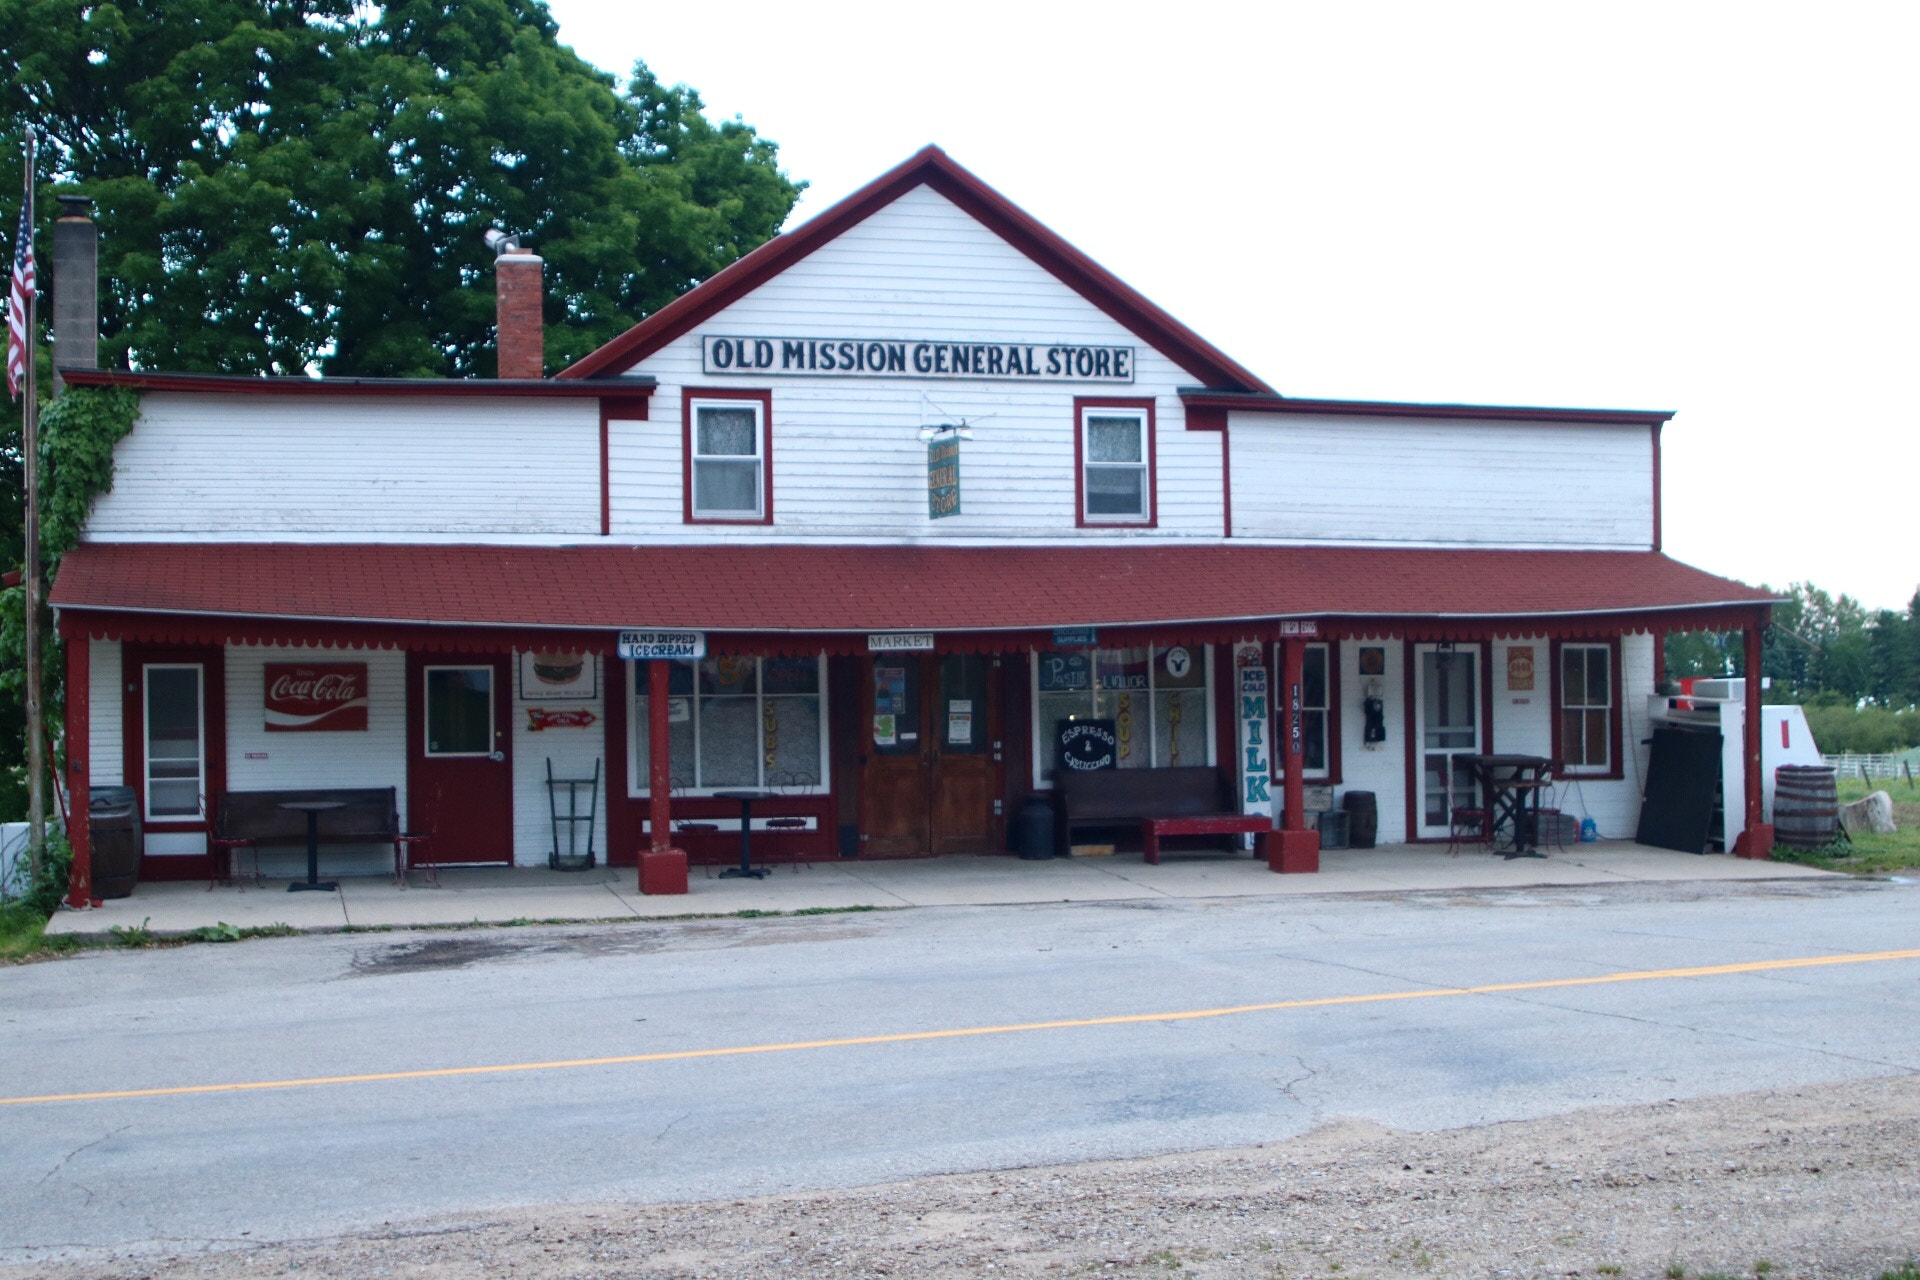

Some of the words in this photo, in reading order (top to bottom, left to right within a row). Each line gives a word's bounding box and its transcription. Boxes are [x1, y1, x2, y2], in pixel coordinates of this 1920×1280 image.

[712, 338, 774, 369] OLD
[782, 340, 906, 372] MISSION
[913, 343, 1040, 375] GENERAL
[1046, 346, 1129, 377] STORE
[929, 464, 957, 489] GENERAL
[931, 487, 957, 514] STORE
[622, 633, 654, 644] HAND
[657, 633, 696, 644] DIPPED
[870, 634, 932, 648] MARKET
[271, 674, 357, 700] Coca-Cola
[1242, 670, 1264, 681] ICE
[1242, 683, 1265, 692] COLD
[1118, 694, 1132, 759] SOUP
[1292, 684, 1300, 753] 18250
[765, 701, 777, 770] SUBS
[1061, 726, 1115, 745] ESPRESSO
[1084, 740, 1092, 752] &
[1242, 695, 1271, 802] MILK
